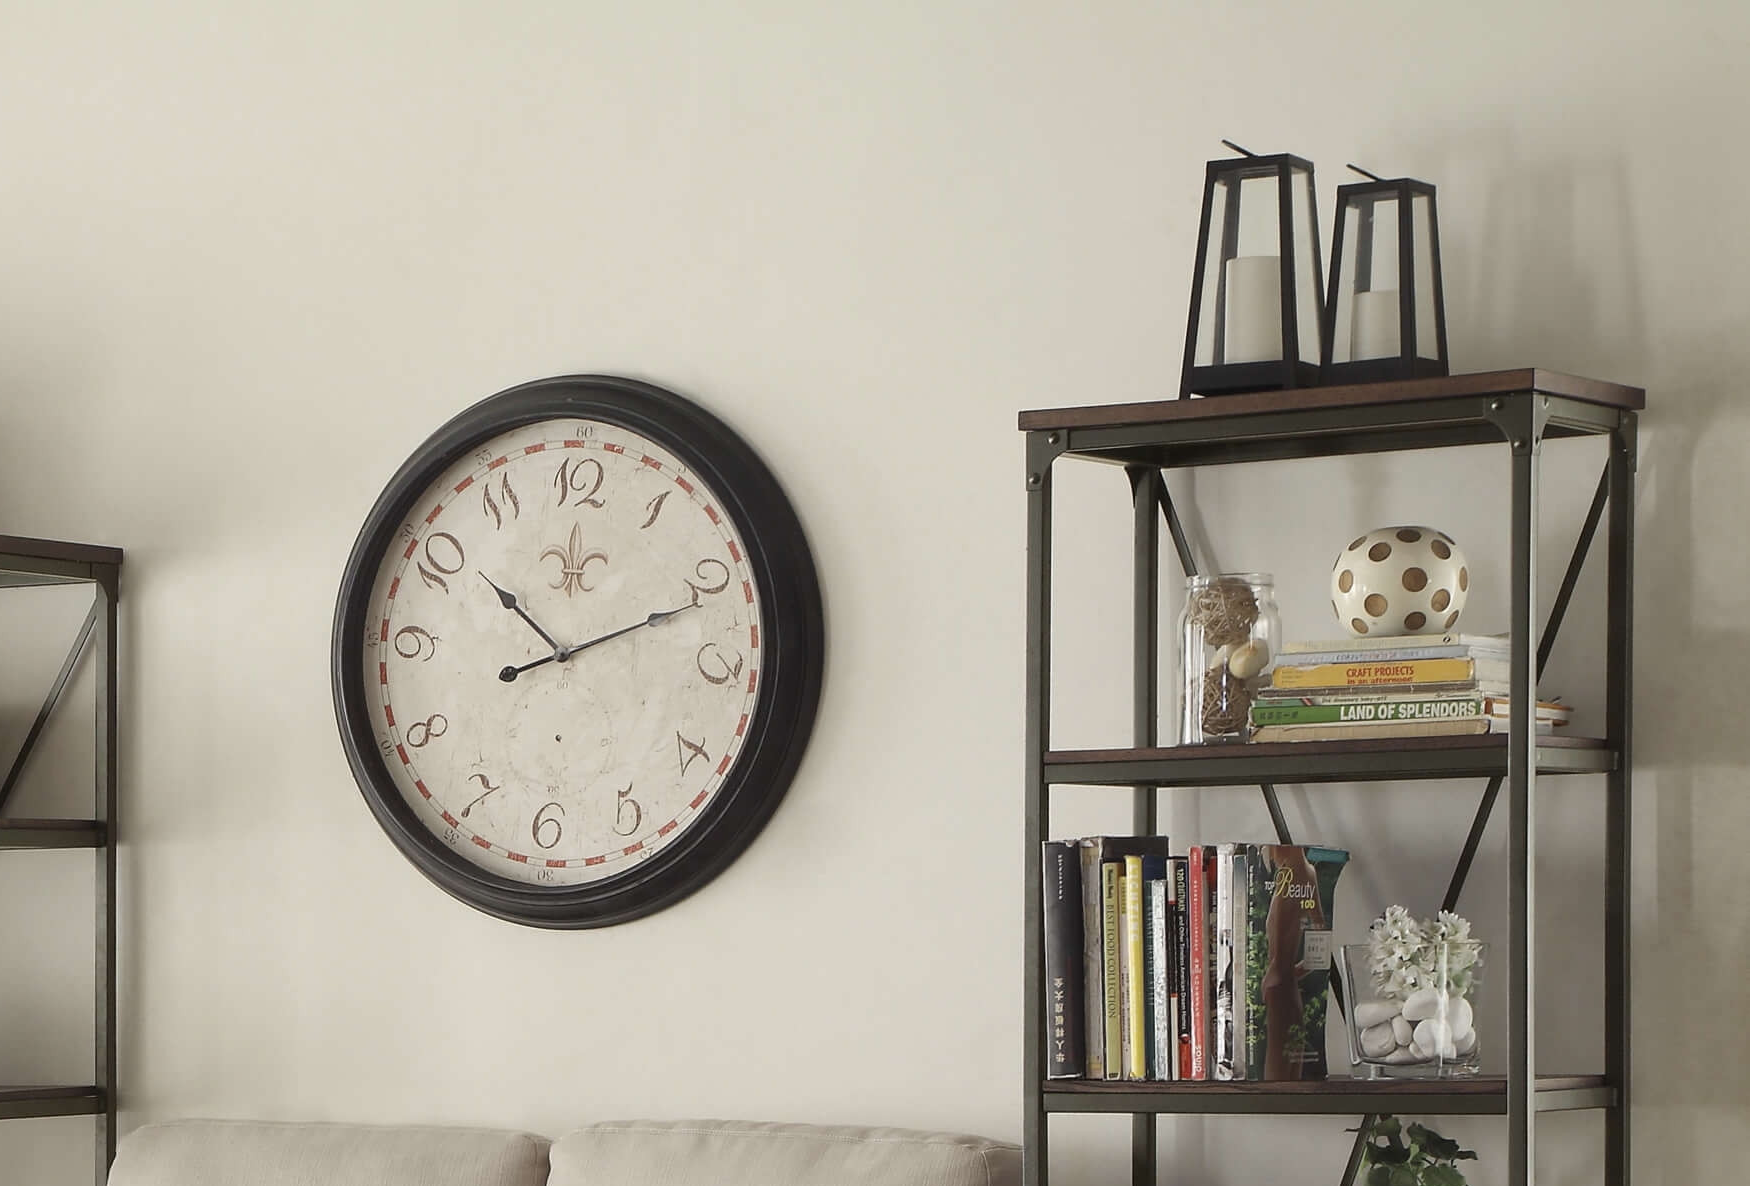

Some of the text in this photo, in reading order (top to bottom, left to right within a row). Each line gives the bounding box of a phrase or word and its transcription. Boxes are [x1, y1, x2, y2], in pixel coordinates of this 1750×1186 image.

[576, 425, 594, 438] 60
[482, 471, 521, 531] 11
[553, 457, 607, 509] 12
[639, 490, 673, 530] 1
[416, 531, 466, 596] 10
[682, 557, 731, 608] 2
[394, 625, 436, 663] 9
[1346, 665, 1415, 678] CRAFT PROJECTS
[406, 713, 449, 749] 8
[1339, 702, 1476, 721] LAND OF SPLENDORS
[676, 730, 711, 777] 4
[460, 772, 501, 818] 7
[612, 781, 643, 837] 5
[531, 801, 566, 850] 6
[1129, 862, 1139, 943] LIGHTING
[1264, 866, 1315, 899] TOP Beauty
[1106, 904, 1116, 926] BEST
[1299, 899, 1316, 910] 100
[1107, 928, 1116, 957] FOOD
[1107, 958, 1117, 1019] COLLECTION
